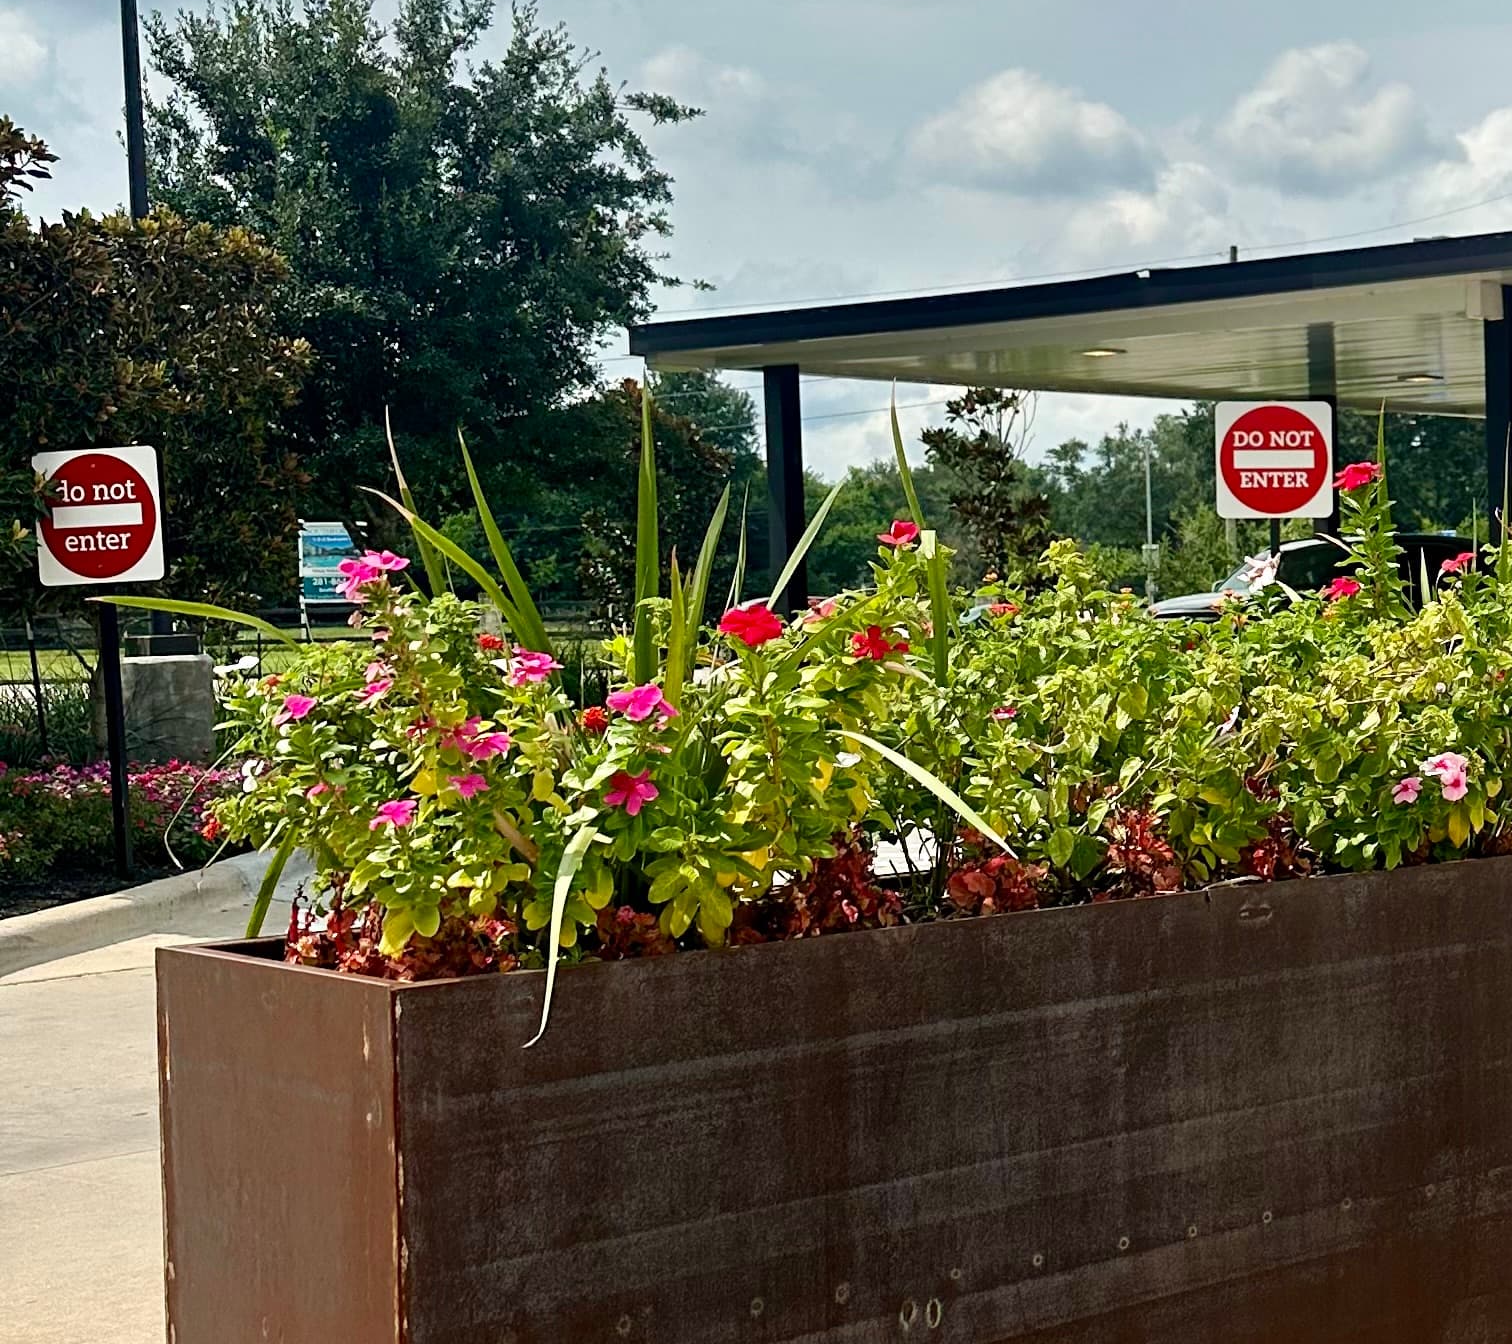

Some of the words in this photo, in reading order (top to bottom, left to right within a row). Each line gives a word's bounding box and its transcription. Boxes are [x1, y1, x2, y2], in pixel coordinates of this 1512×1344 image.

[1232, 430, 1264, 447] DO
[1268, 430, 1315, 447] NOT
[1239, 470, 1309, 489] ENTER
[92, 479, 137, 501] not
[64, 531, 132, 552] enter
